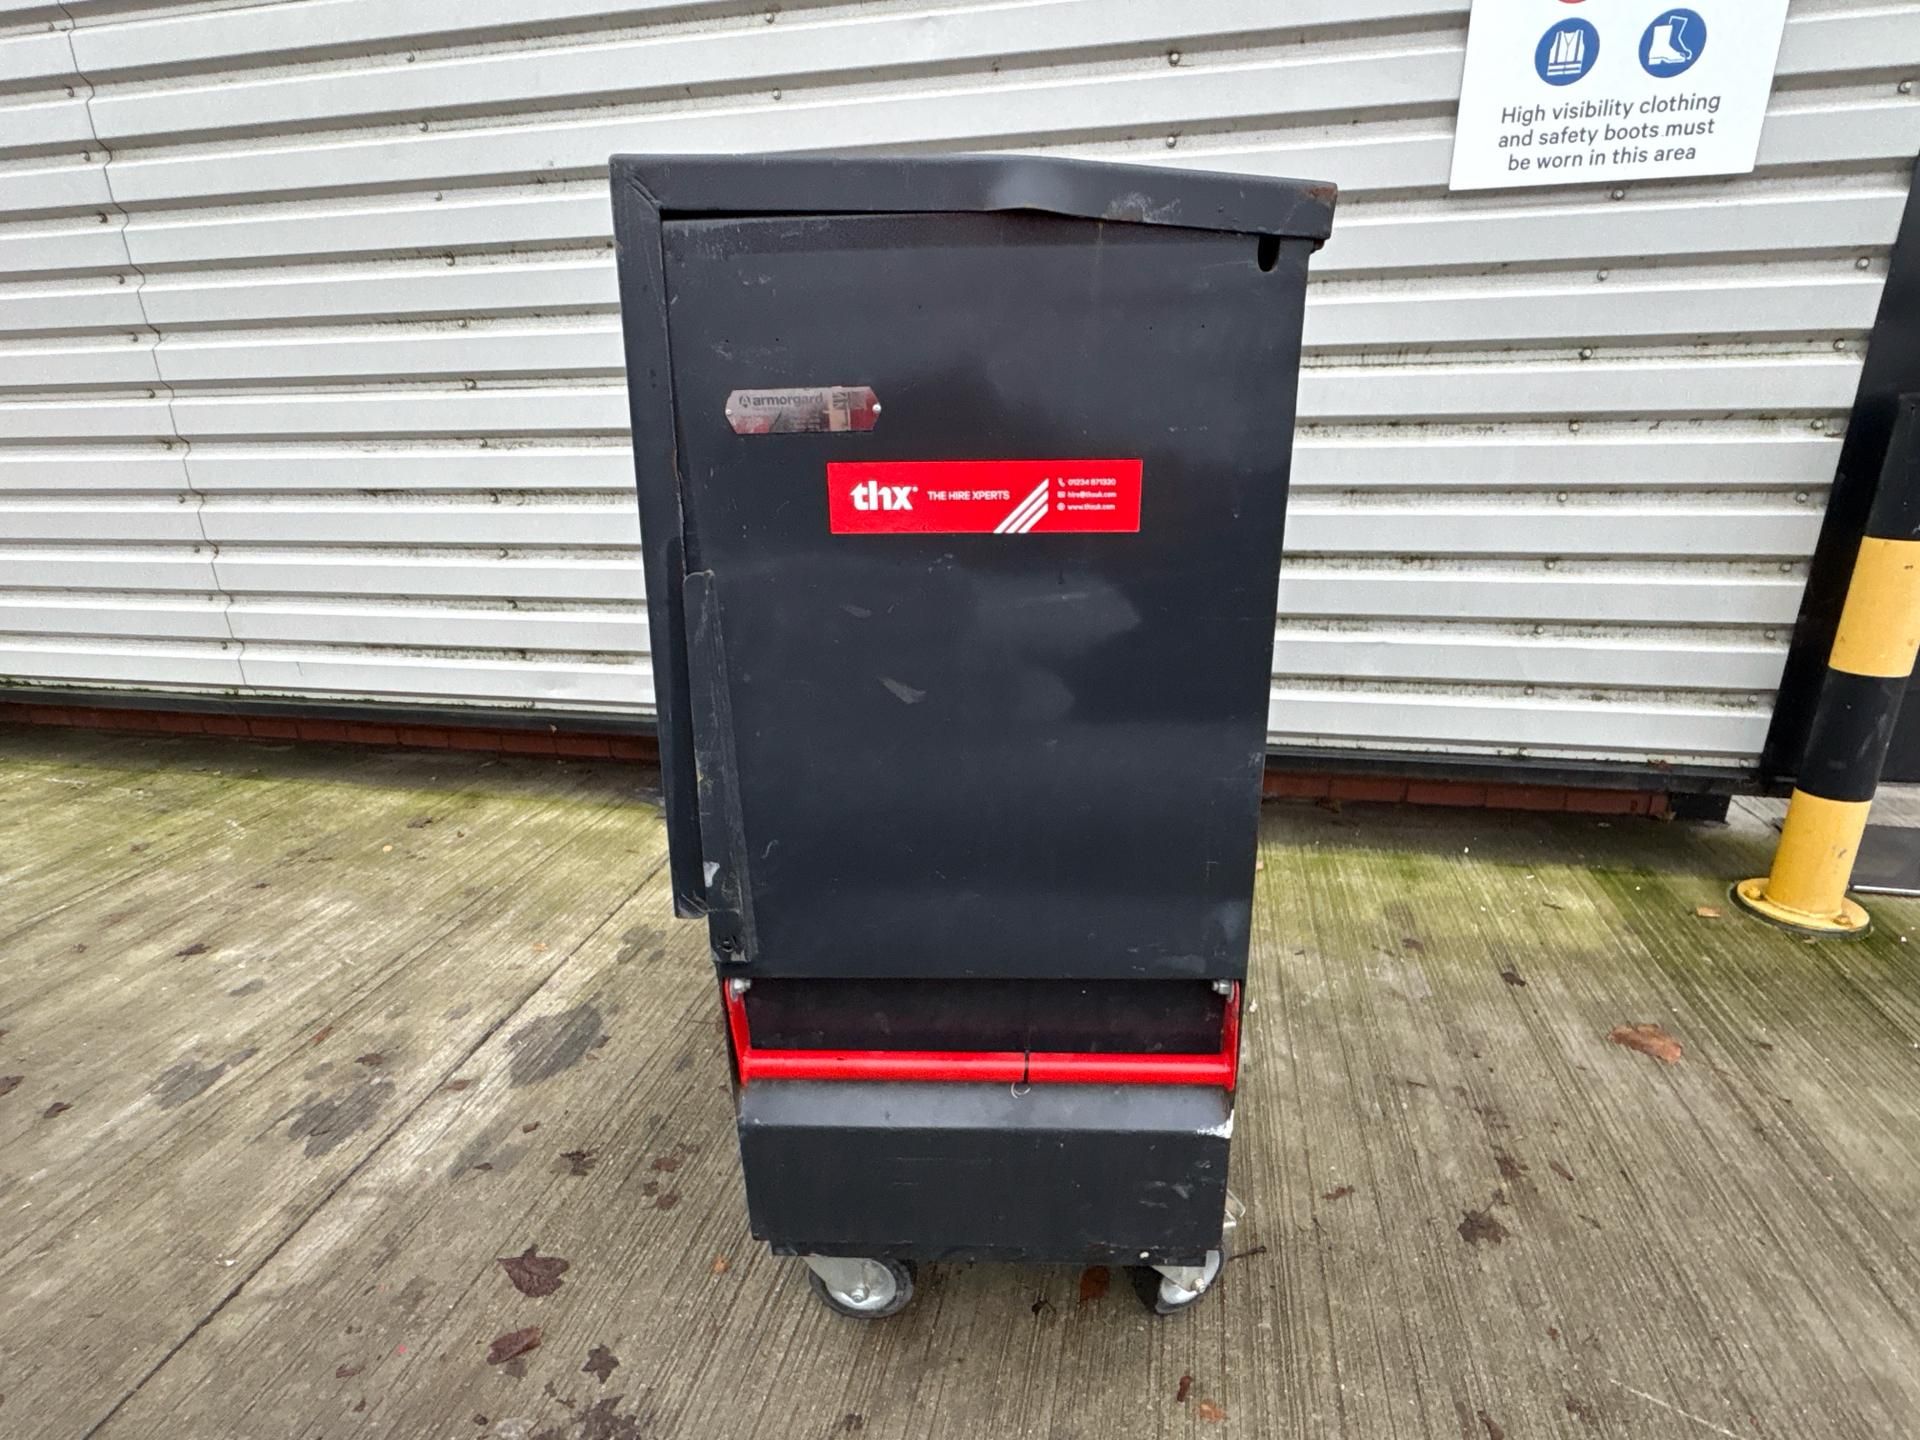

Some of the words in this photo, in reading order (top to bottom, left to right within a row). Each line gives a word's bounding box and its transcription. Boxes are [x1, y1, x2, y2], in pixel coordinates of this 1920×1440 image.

[1501, 104, 1545, 126] High
[1552, 99, 1634, 121] visibility
[1639, 93, 1721, 113] clothing
[1498, 128, 1532, 148] and
[1539, 126, 1598, 146] safety
[1604, 123, 1659, 141] boots
[1665, 118, 1715, 137] must
[1508, 154, 1531, 171] be
[1537, 152, 1583, 169] worn
[1589, 150, 1606, 166] in
[1612, 147, 1648, 164] this
[1654, 145, 1696, 162] area
[753, 392, 824, 406] armorgard
[927, 490, 947, 501] THE
[948, 490, 971, 501] HIRE
[972, 490, 1011, 501] XPERTS
